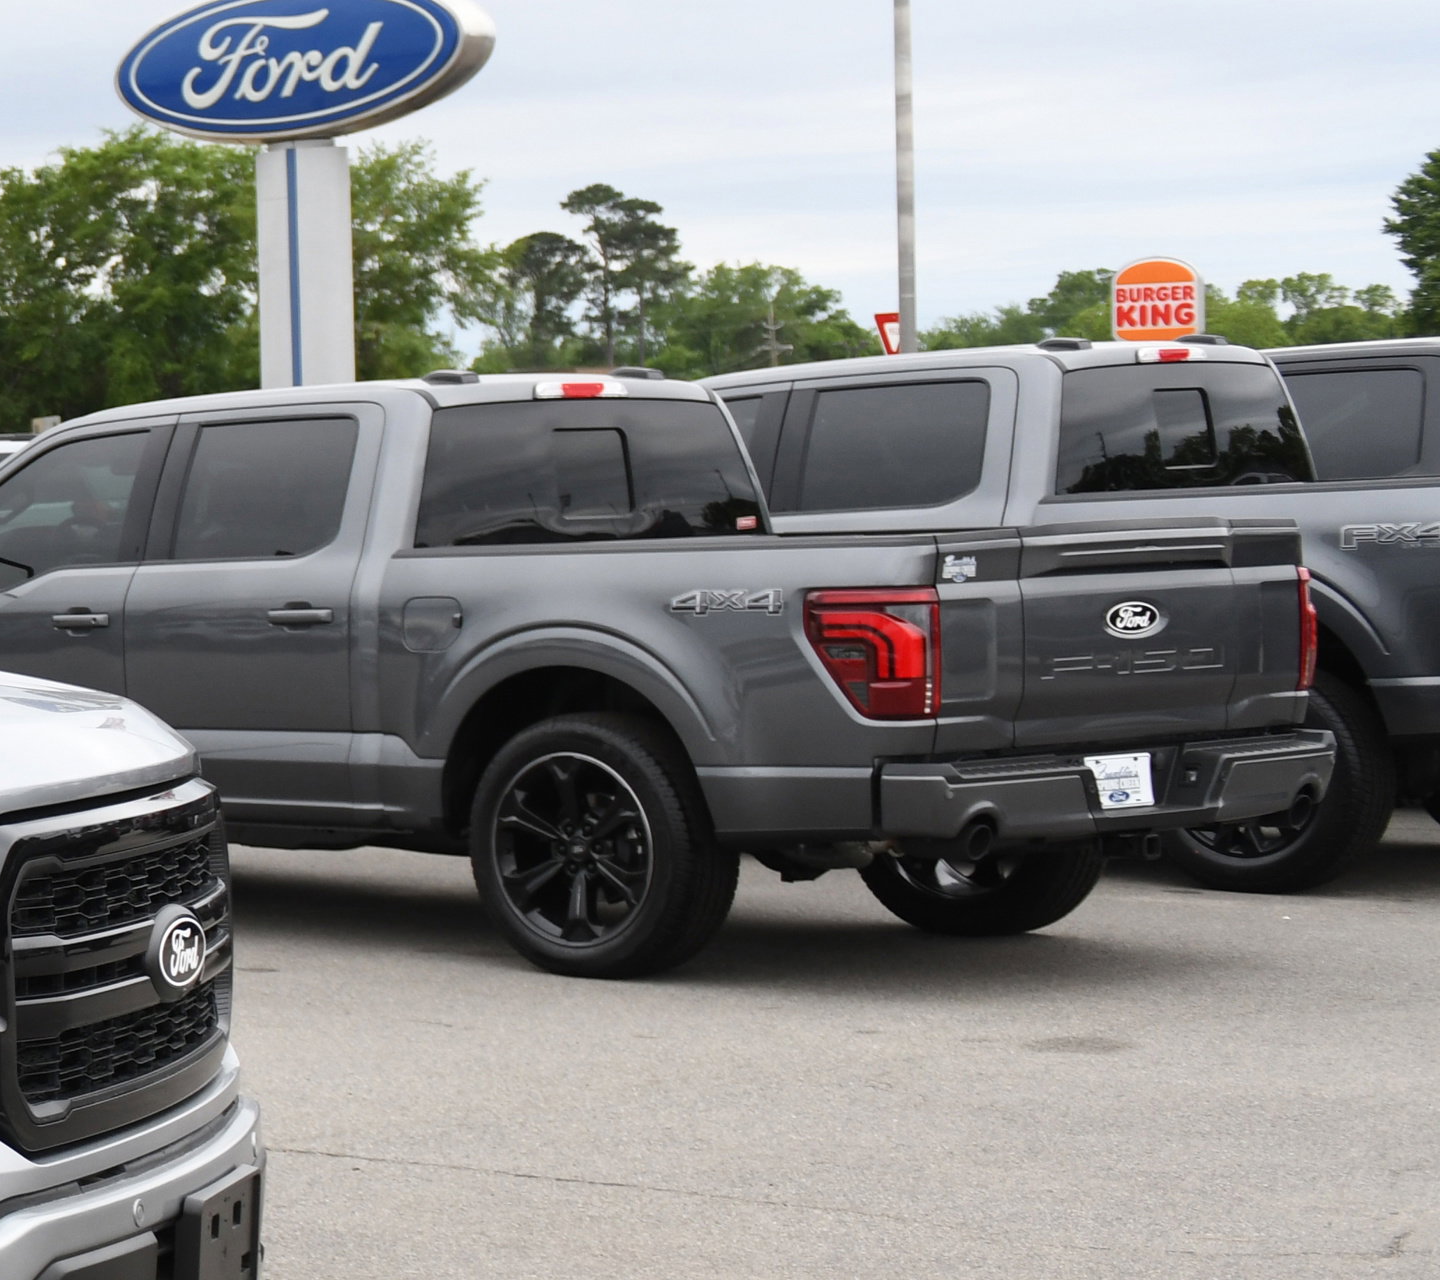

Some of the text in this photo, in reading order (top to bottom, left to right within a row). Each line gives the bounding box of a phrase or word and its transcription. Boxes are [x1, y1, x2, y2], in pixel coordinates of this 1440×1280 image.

[181, 7, 383, 110] Ford
[1115, 285, 1195, 303] BURGER
[1116, 302, 1195, 328] KING
[1115, 606, 1152, 629] Ford
[170, 927, 199, 977] Ford
